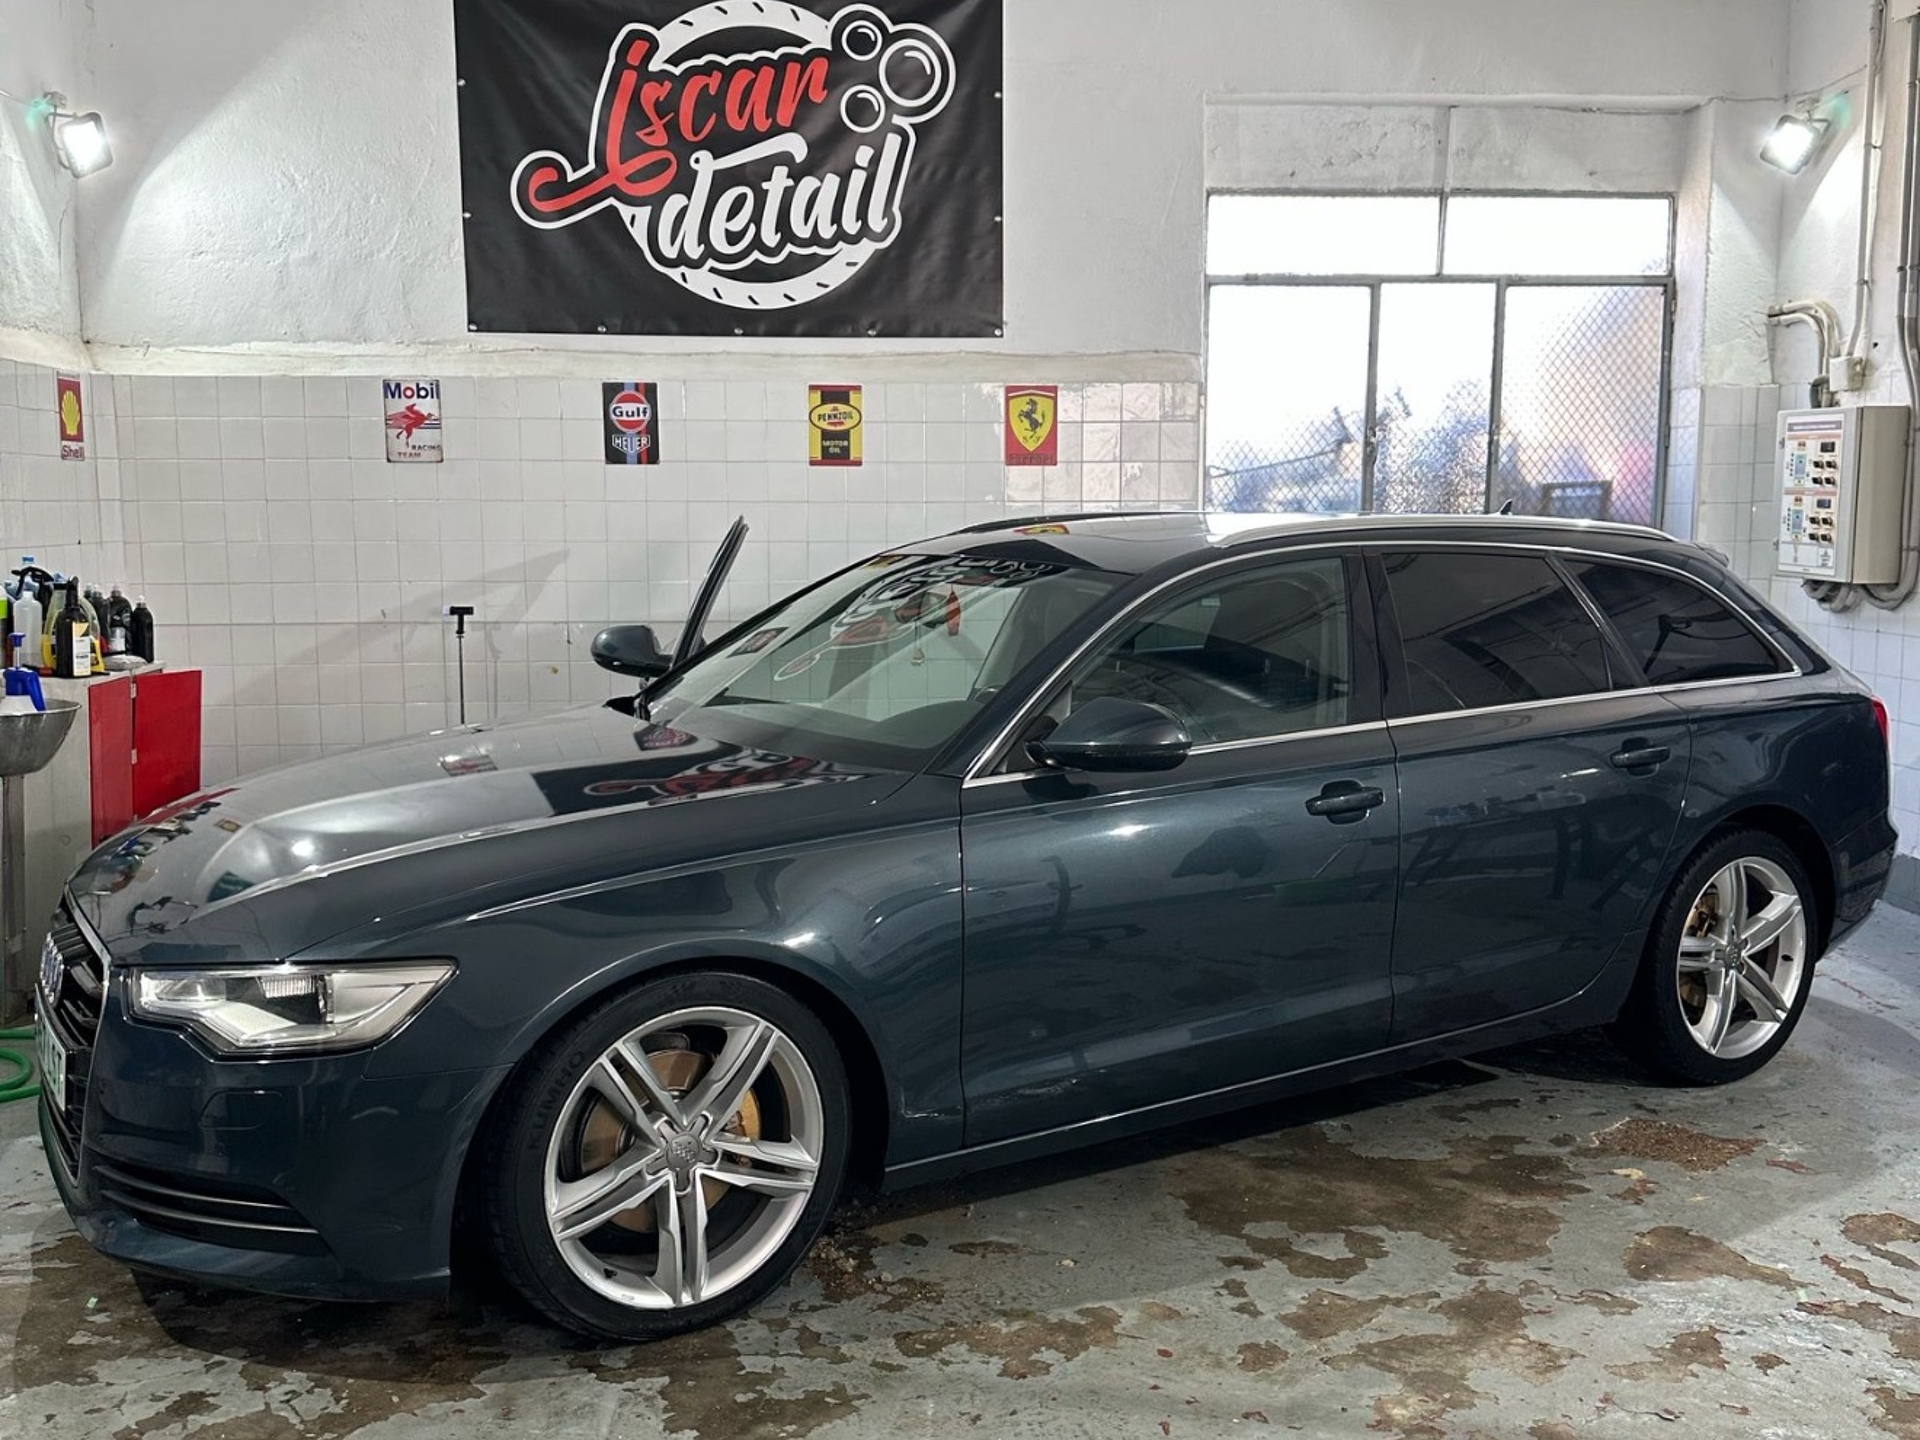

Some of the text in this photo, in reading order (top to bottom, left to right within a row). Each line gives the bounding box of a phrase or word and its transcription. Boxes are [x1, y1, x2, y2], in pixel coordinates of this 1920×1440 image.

[656, 130, 903, 260] detail
[384, 382, 440, 400] Mobil
[612, 405, 648, 418] Gulf
[60, 444, 84, 460] Shell
[613, 436, 649, 453] HEUER
[397, 451, 422, 459] TEAM
